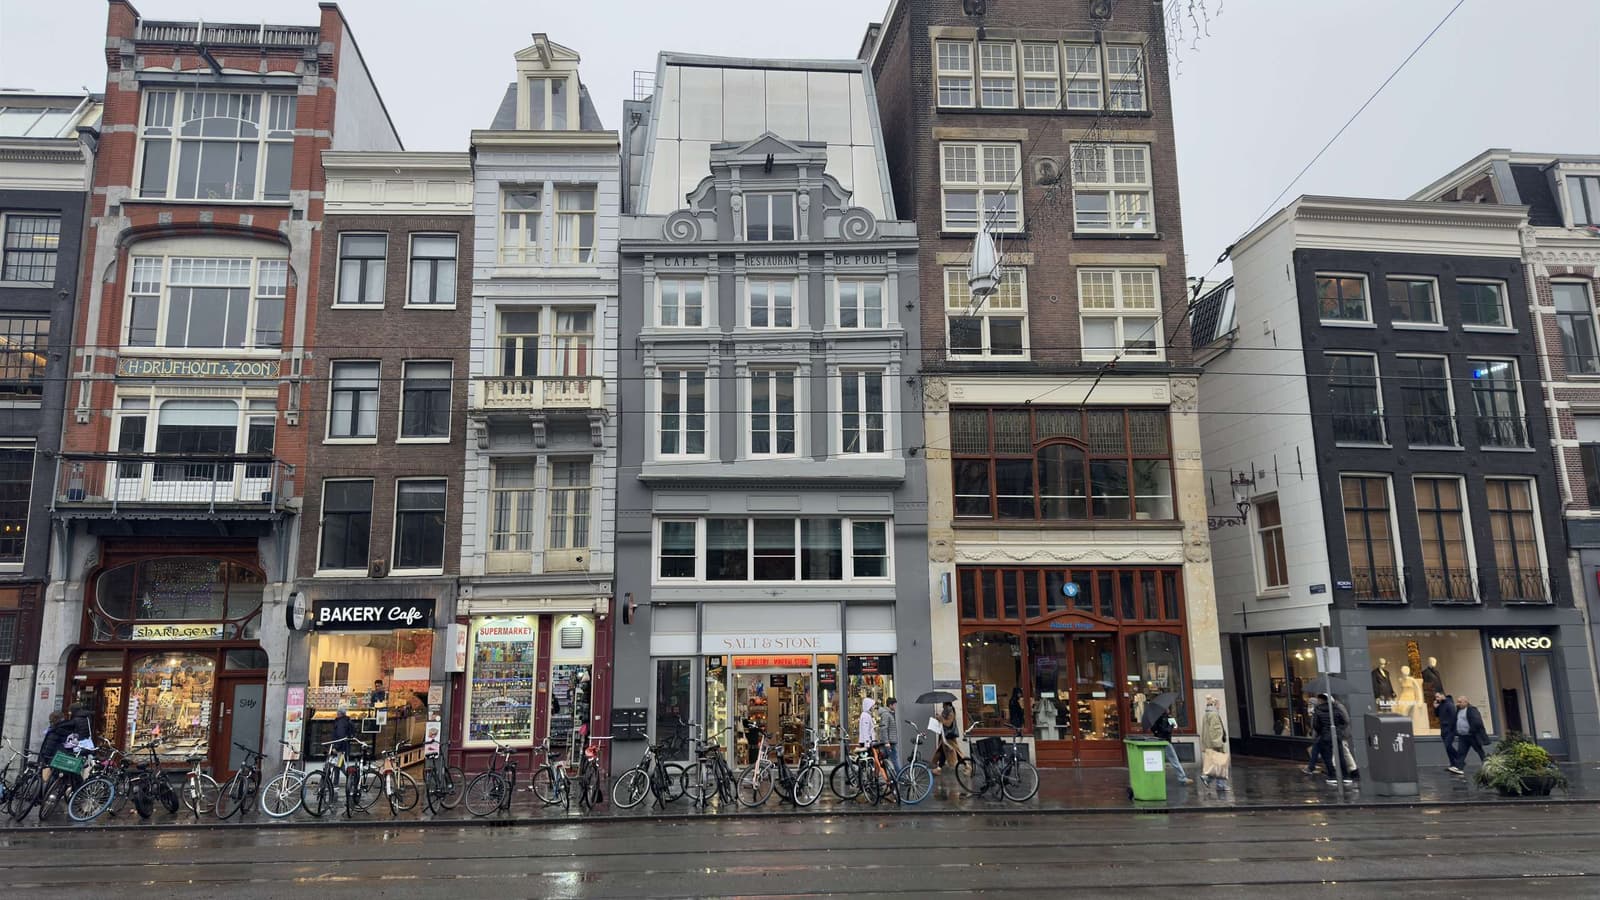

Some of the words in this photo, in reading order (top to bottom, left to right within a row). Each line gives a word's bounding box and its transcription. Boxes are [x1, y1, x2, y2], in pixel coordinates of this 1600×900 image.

[744, 256, 799, 267] RESTAURANT
[835, 256, 850, 265] DE
[855, 255, 885, 265] POOL
[220, 364, 230, 375] &
[233, 361, 271, 375] ZOON
[320, 607, 384, 621] BAKERY
[388, 606, 423, 625] Cafe
[480, 627, 532, 636] SUPERMARKET
[723, 637, 760, 649] SALT
[762, 638, 772, 649] &
[775, 637, 821, 649] STONE
[1491, 636, 1551, 650] MANGO
